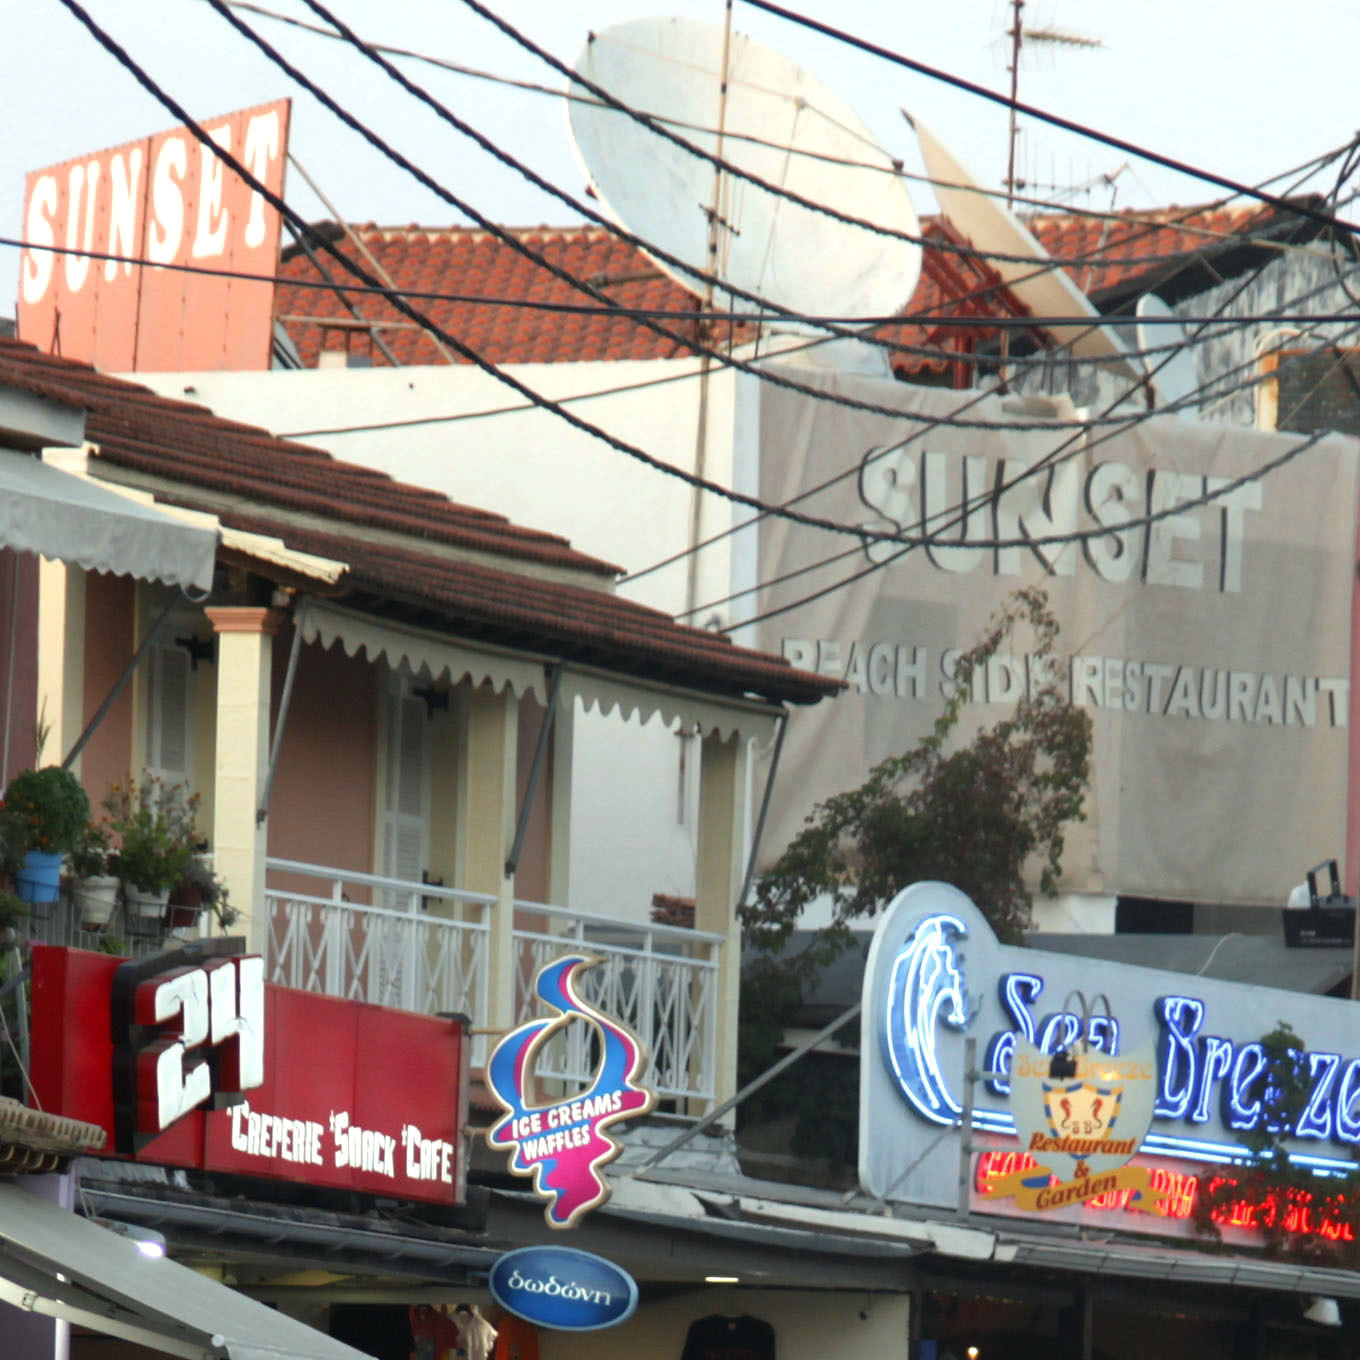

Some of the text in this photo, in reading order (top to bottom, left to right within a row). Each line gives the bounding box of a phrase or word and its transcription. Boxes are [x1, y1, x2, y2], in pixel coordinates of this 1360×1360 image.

[24, 110, 280, 304] SUNSET
[858, 445, 1263, 593] SUNSET
[1070, 653, 1351, 728] RESTAURANT
[140, 955, 265, 1132] 24
[512, 1090, 623, 1137] ICE CREAMS
[521, 1125, 591, 1162] WAFFLES
[1028, 1132, 1137, 1156] Restaurant
[1073, 1160, 1090, 1178] &
[1035, 1174, 1117, 1210] Garden
[507, 1268, 613, 1307] δωδώνη
